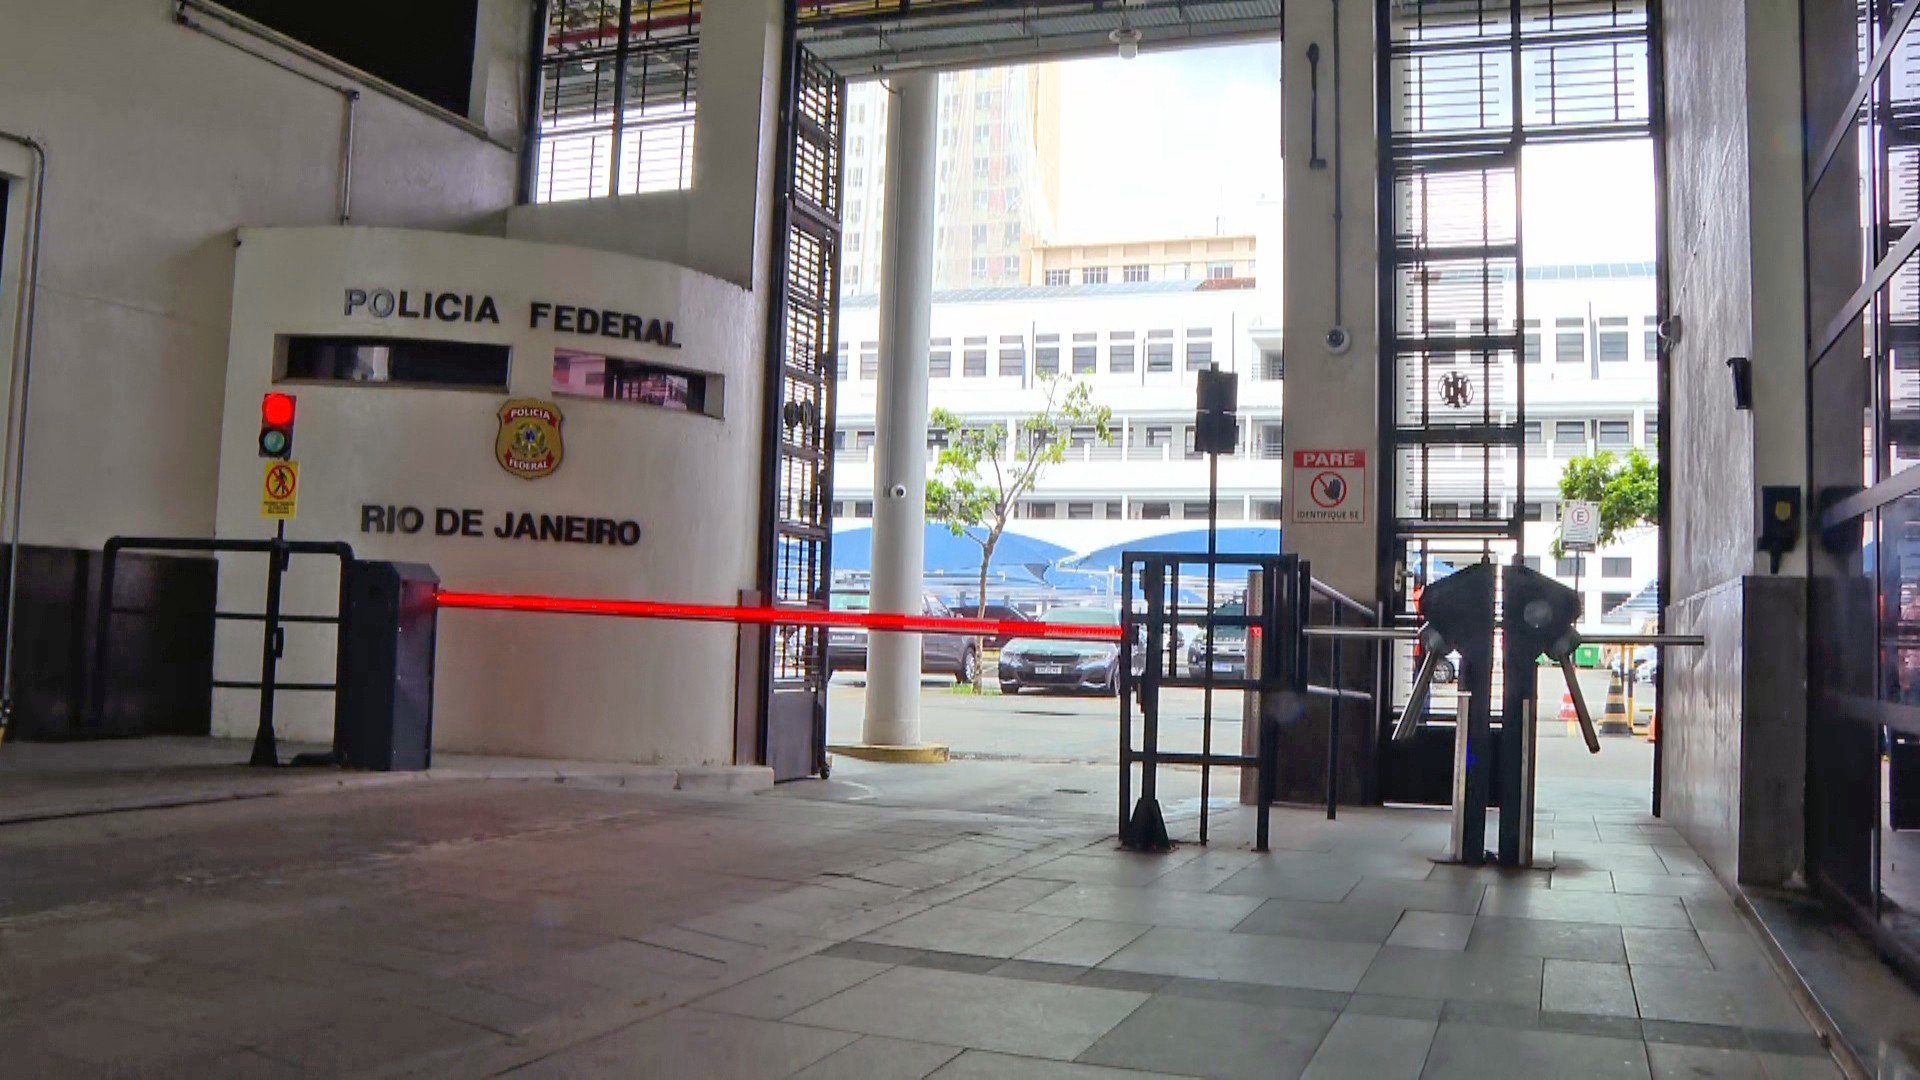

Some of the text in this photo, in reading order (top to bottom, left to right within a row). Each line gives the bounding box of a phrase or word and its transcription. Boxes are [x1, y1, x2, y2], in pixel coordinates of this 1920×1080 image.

[344, 288, 682, 349] POLICIA FEDERAL
[509, 458, 548, 470] FEDERAL
[1303, 452, 1356, 467] PARE
[360, 504, 641, 547] RIO DE JANEIRO
